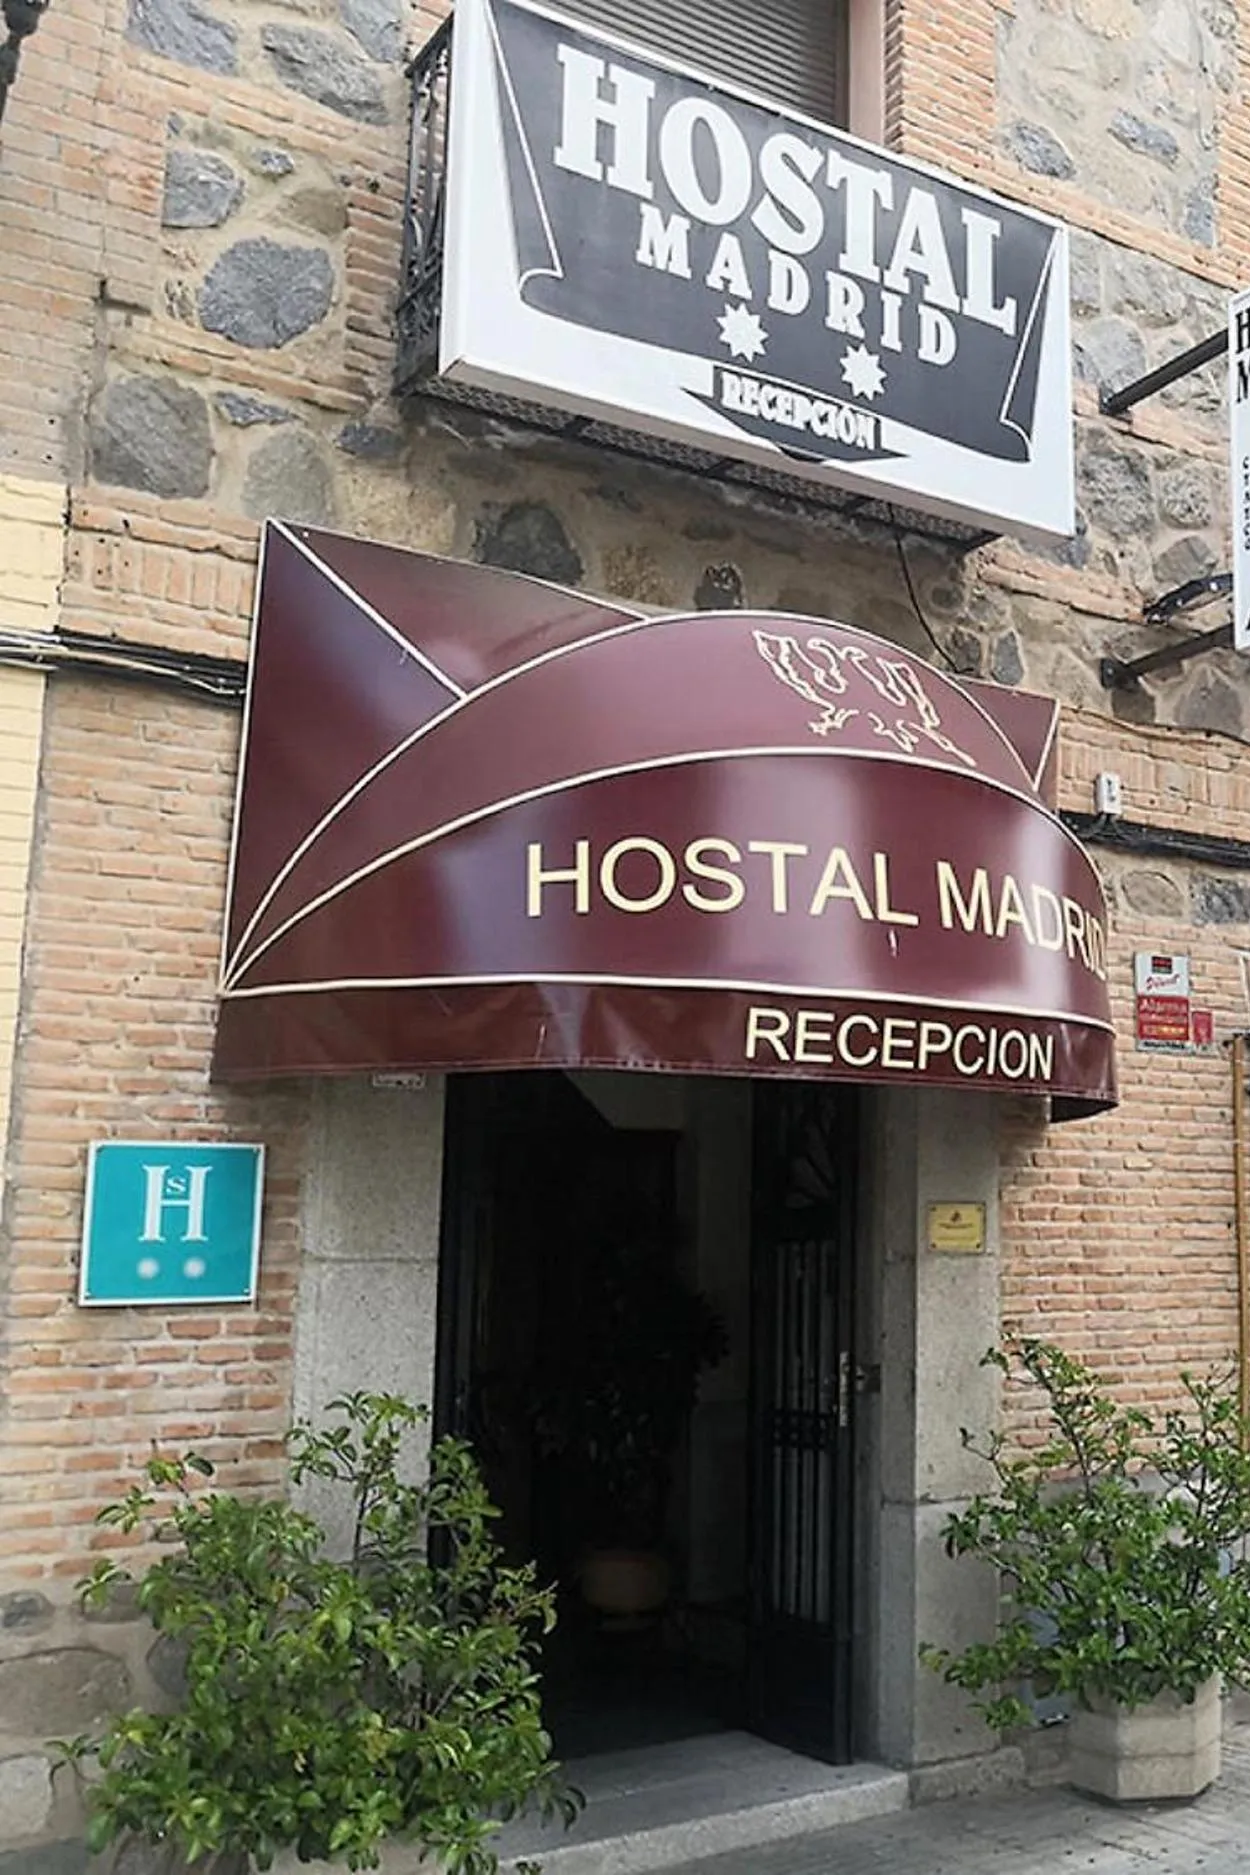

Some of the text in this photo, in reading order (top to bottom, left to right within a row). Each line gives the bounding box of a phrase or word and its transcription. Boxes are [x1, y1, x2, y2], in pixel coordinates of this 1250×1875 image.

[554, 44, 1017, 335] HOSTAL
[636, 202, 956, 366] MADRID
[526, 836, 919, 926] HOSTAL
[745, 1006, 1054, 1081] RECEPCION
